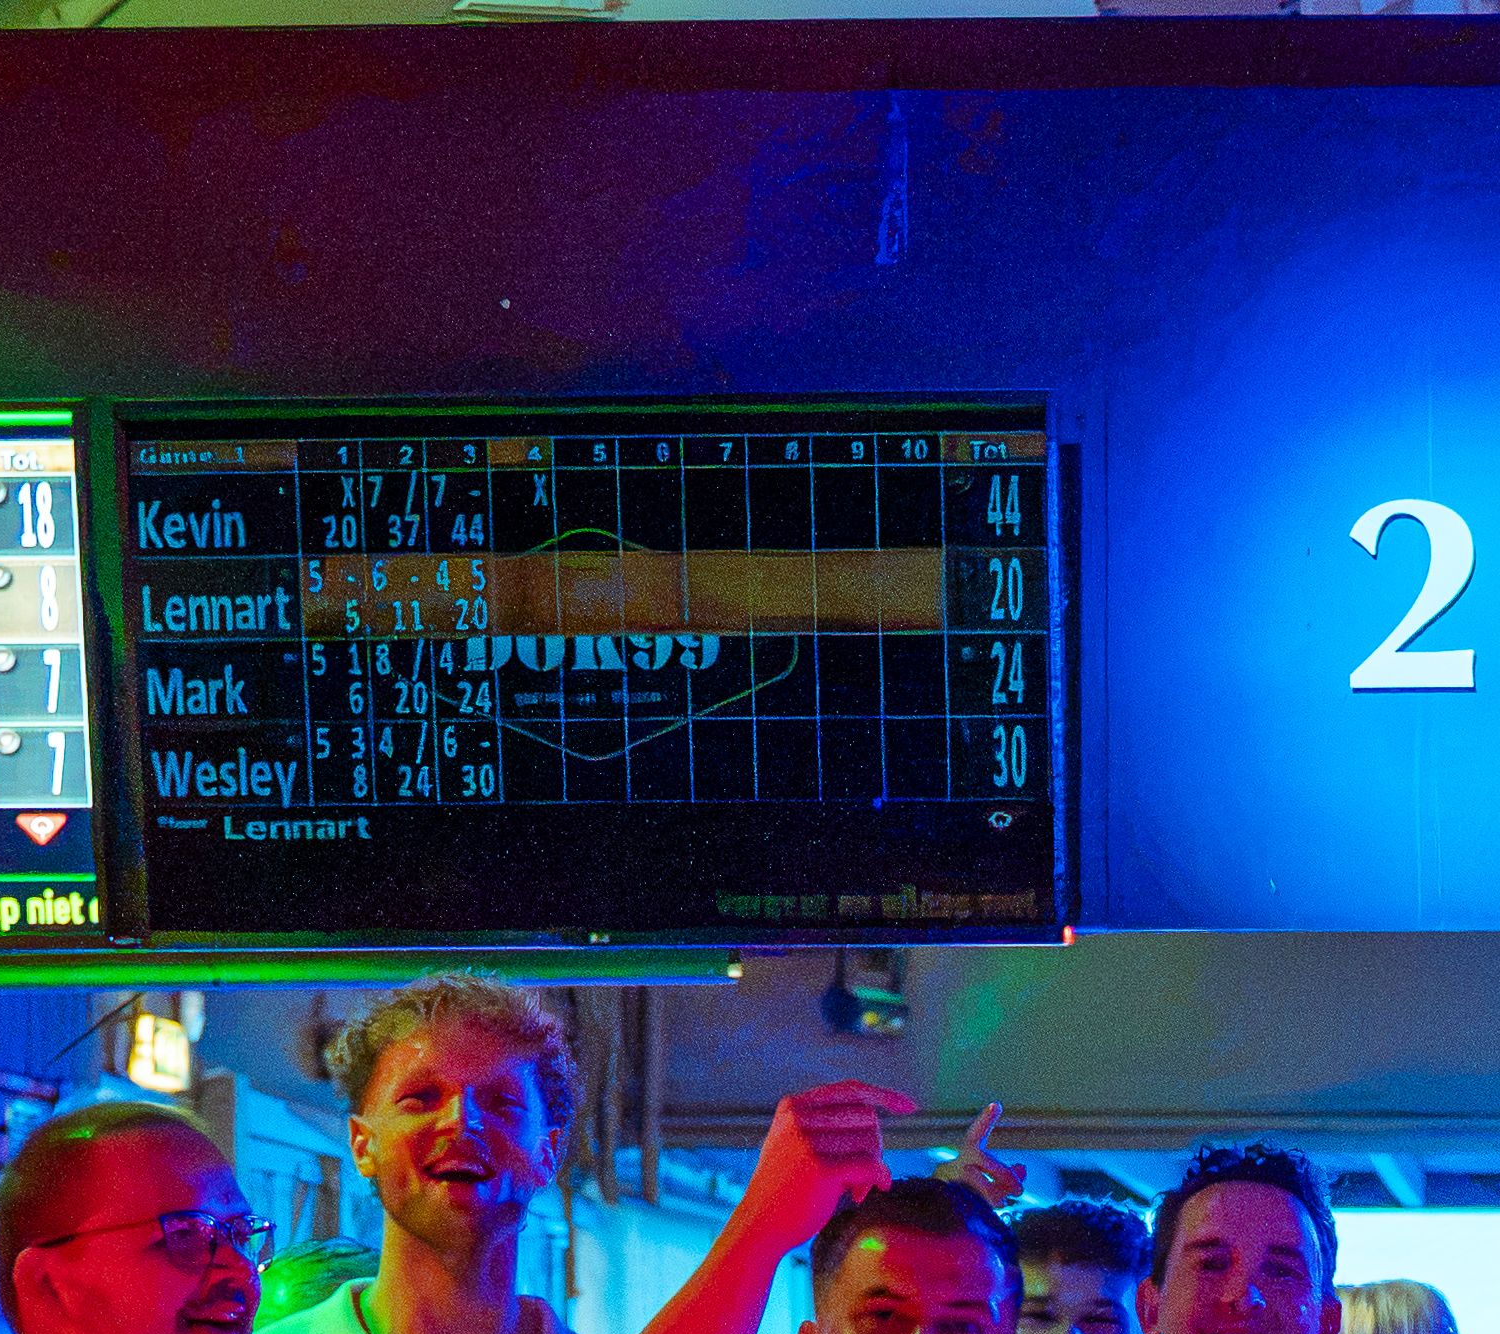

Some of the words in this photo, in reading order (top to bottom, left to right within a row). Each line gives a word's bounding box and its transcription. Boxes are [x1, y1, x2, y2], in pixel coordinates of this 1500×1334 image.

[19, 481, 56, 548] 18
[340, 475, 356, 508] X
[367, 476, 383, 509] 7
[431, 475, 447, 508] 7
[533, 473, 548, 506] X
[987, 475, 1021, 536] 44
[138, 499, 246, 549] Kevin
[322, 515, 358, 549] 20
[388, 515, 420, 549] 37
[451, 514, 485, 547] 44
[40, 566, 59, 632] 8
[307, 561, 324, 593] 5
[372, 561, 388, 592] 6
[435, 561, 450, 592] 4
[470, 560, 487, 592] 5
[987, 557, 1023, 621] 20
[1349, 497, 1478, 693] 2
[143, 585, 293, 632] Lennart
[345, 600, 359, 633] 5
[393, 600, 424, 631] 11
[455, 596, 488, 630] 20
[43, 649, 60, 713] 7
[311, 644, 327, 676] 5
[348, 642, 363, 676] 1
[375, 644, 391, 676] 8
[990, 641, 1024, 704] 24
[146, 664, 248, 716] Mark
[349, 682, 365, 715] 6
[393, 682, 429, 715] 20
[457, 682, 493, 715] 24
[48, 731, 66, 796] 7
[316, 728, 330, 759] 5
[352, 727, 366, 759] 3
[379, 727, 394, 758] 4
[443, 725, 458, 758] 6
[991, 725, 1027, 788] 30
[150, 746, 298, 808] Wesley
[353, 765, 368, 799] 8
[398, 766, 433, 798] 24
[462, 764, 495, 798] 30
[223, 816, 373, 840] Lennart
[26, 888, 84, 925] niet
